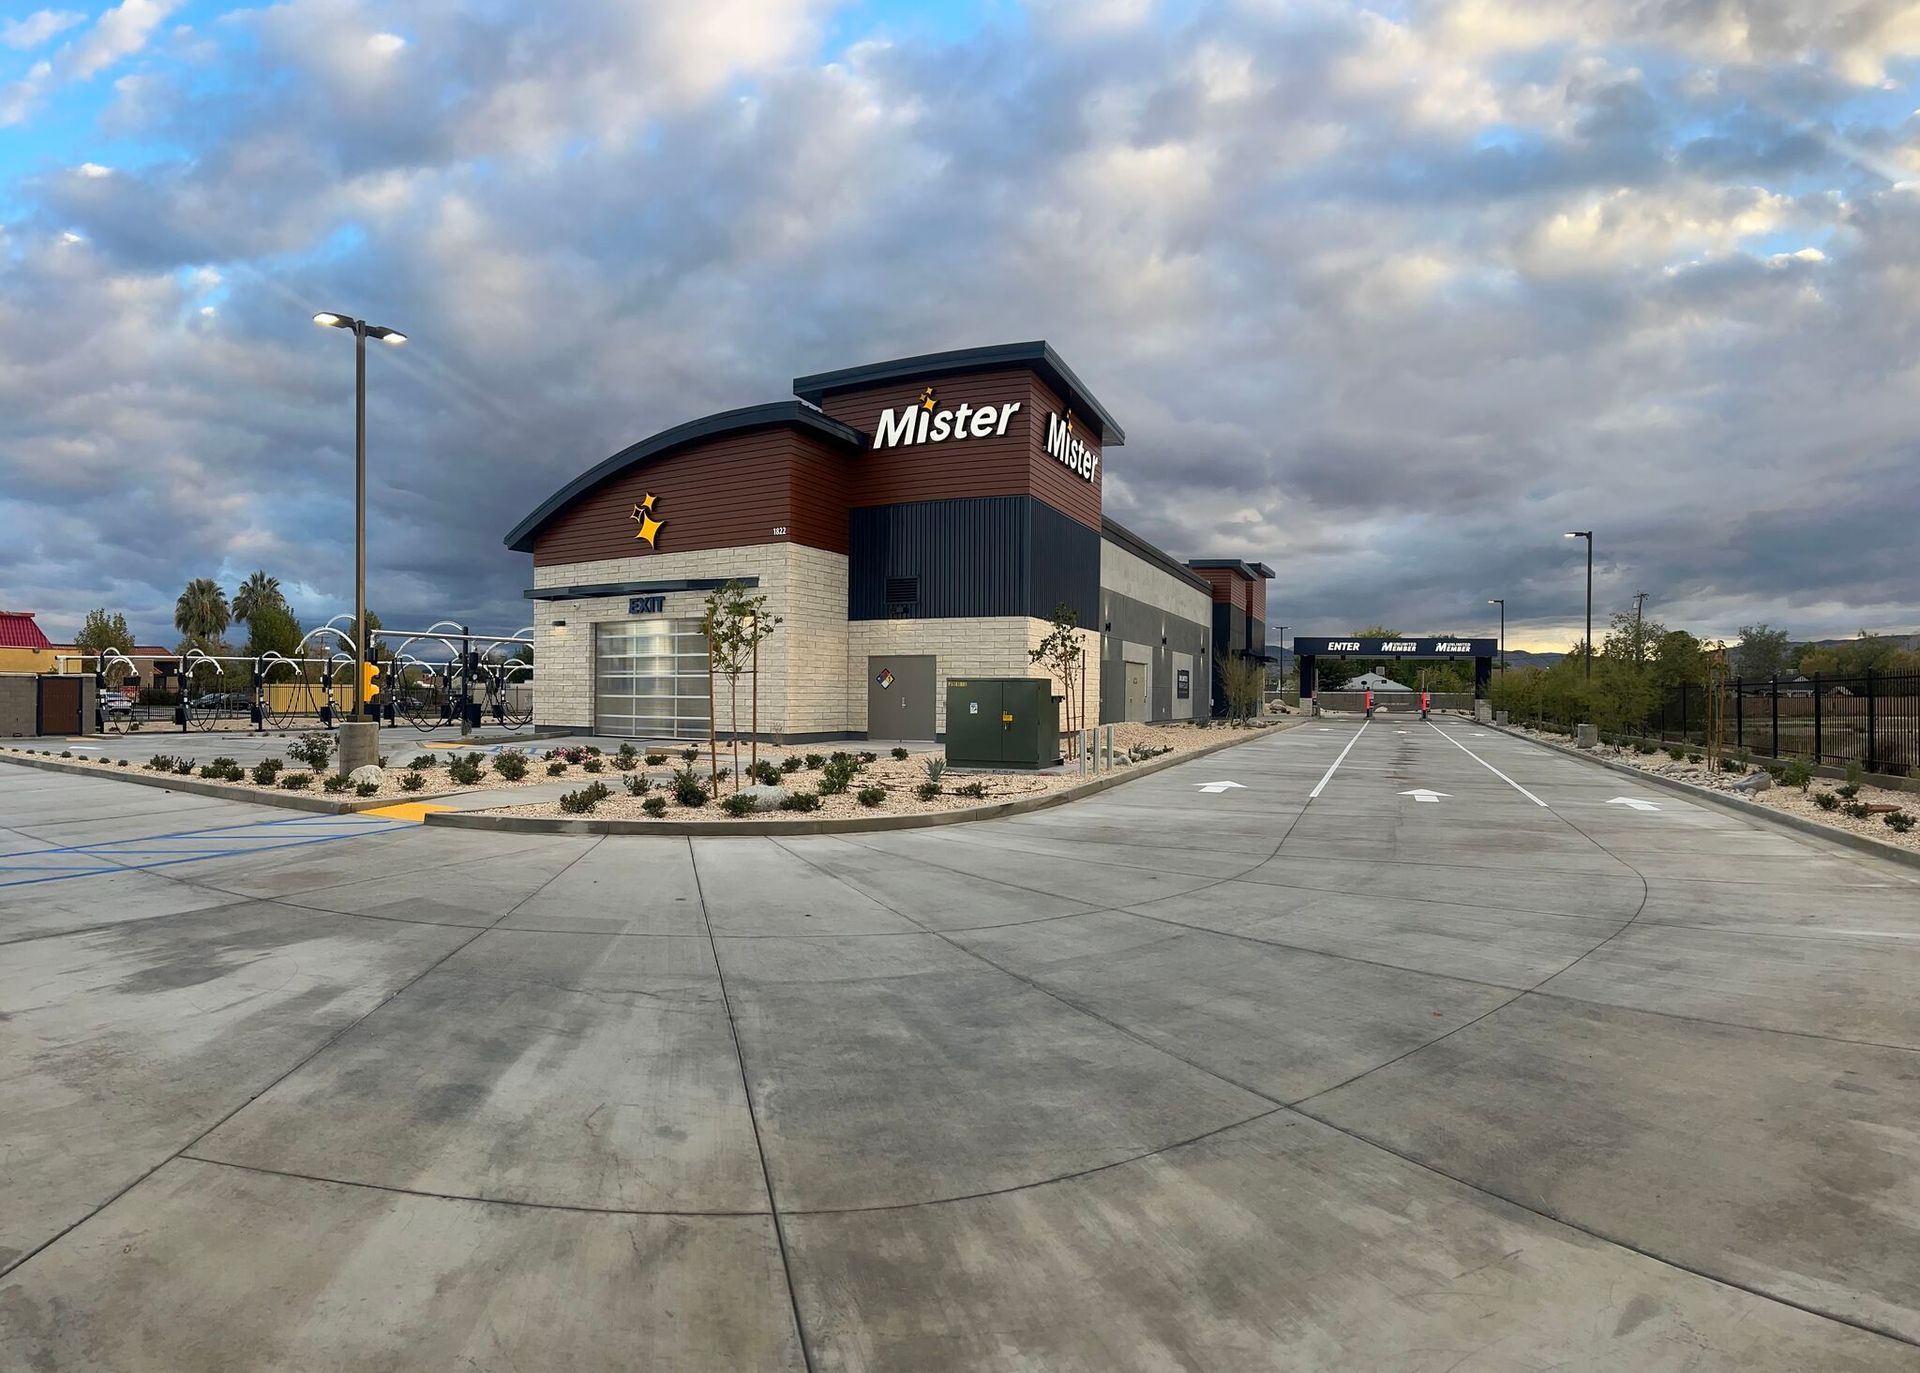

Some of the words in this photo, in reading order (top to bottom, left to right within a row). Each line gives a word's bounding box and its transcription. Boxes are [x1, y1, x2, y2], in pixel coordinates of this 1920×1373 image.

[873, 402, 1021, 449] Mister
[1047, 411, 1099, 483] Mister
[773, 527, 787, 535] 1822
[629, 596, 666, 614] EXIT
[1328, 642, 1360, 651] ENTER
[1381, 642, 1417, 652] MEMBER
[1435, 642, 1471, 652] MEMBER
